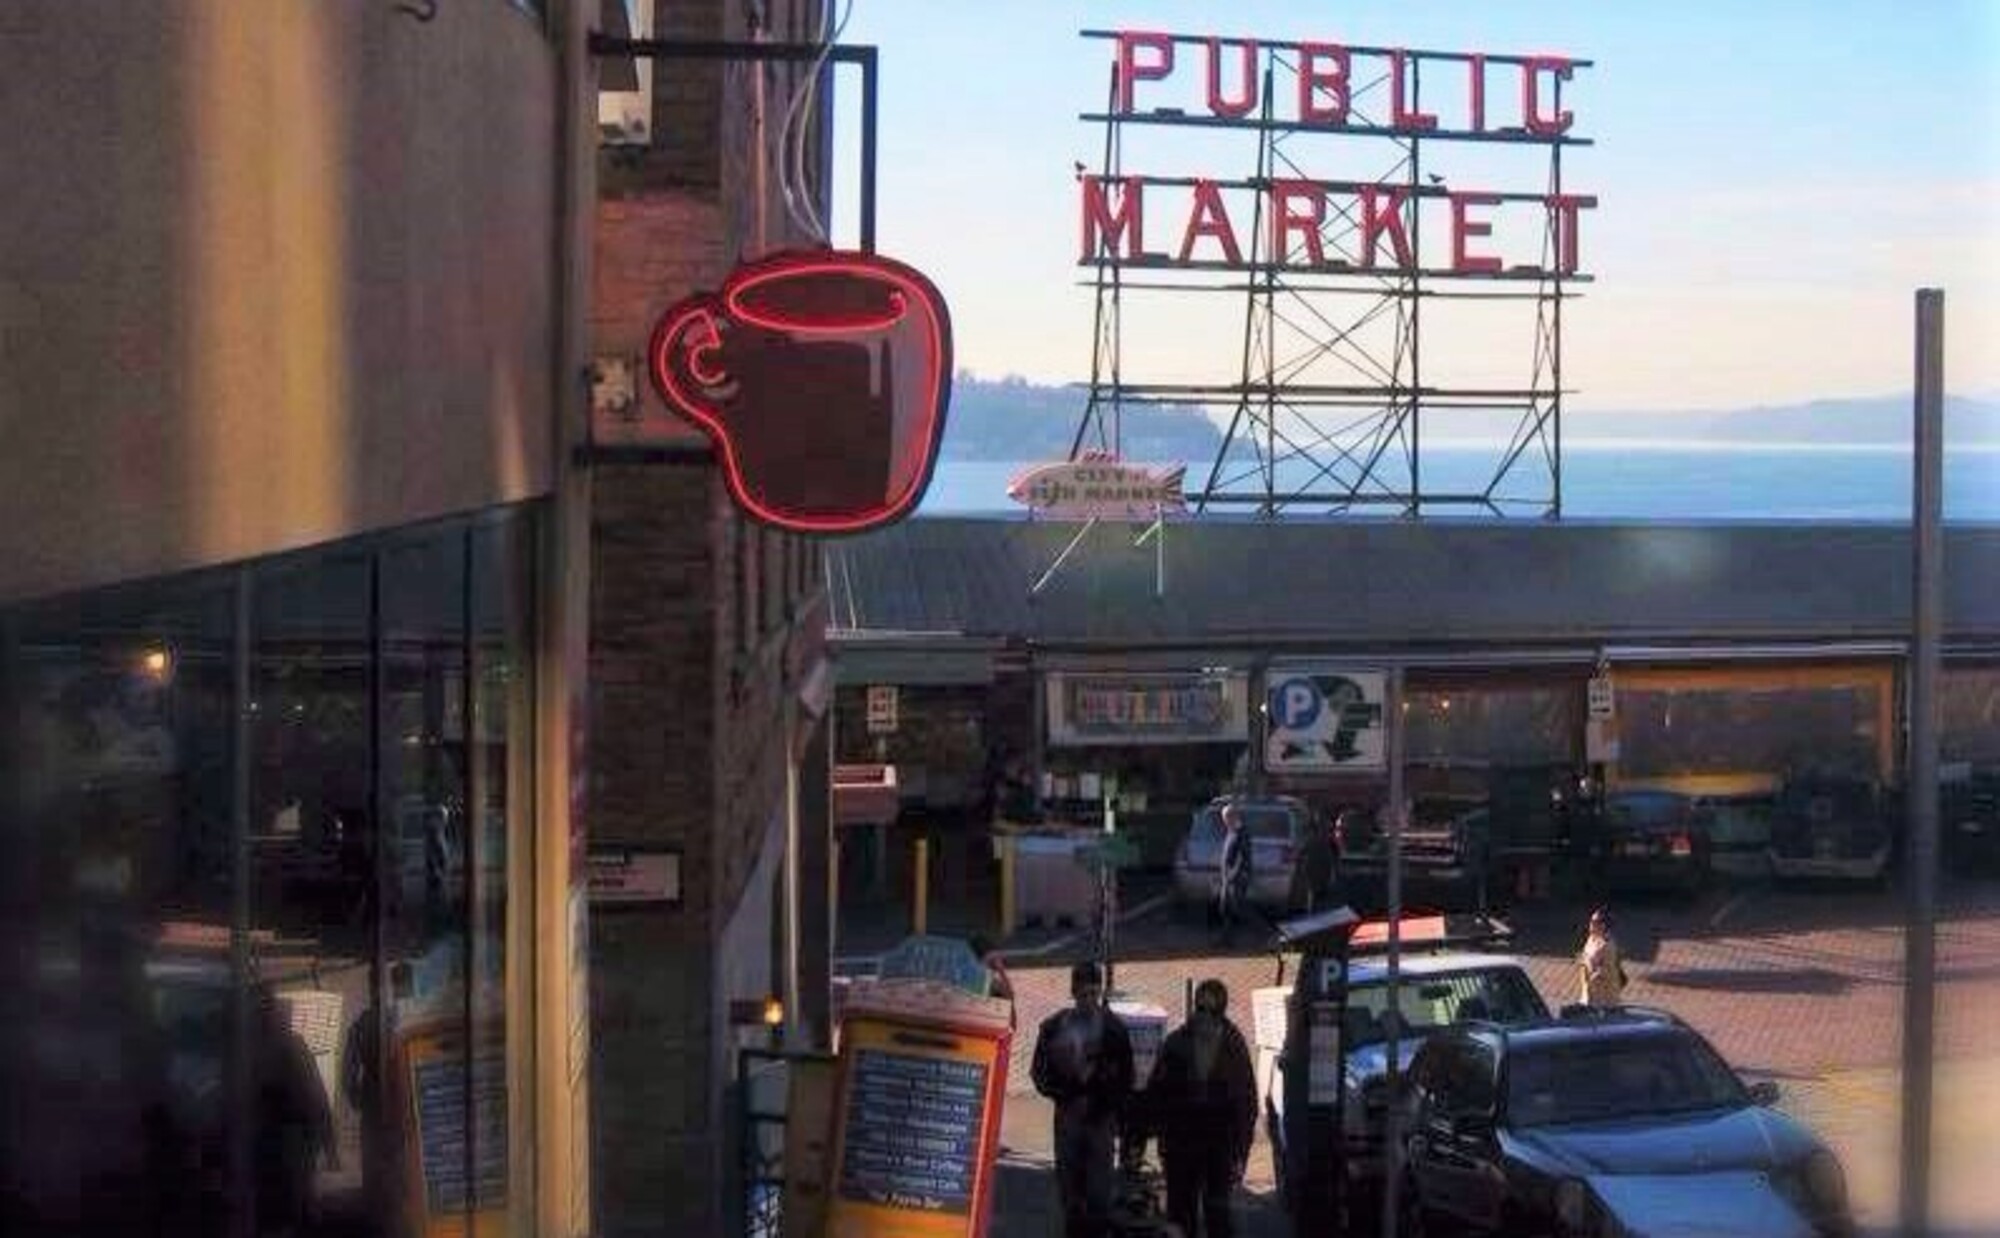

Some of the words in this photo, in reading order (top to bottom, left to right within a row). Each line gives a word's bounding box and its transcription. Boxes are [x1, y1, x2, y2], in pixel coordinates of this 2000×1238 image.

[1116, 30, 1574, 136] PUBLIC
[1078, 174, 1598, 276] MARKET
[1286, 684, 1314, 724] P
[1321, 959, 1342, 993] P
